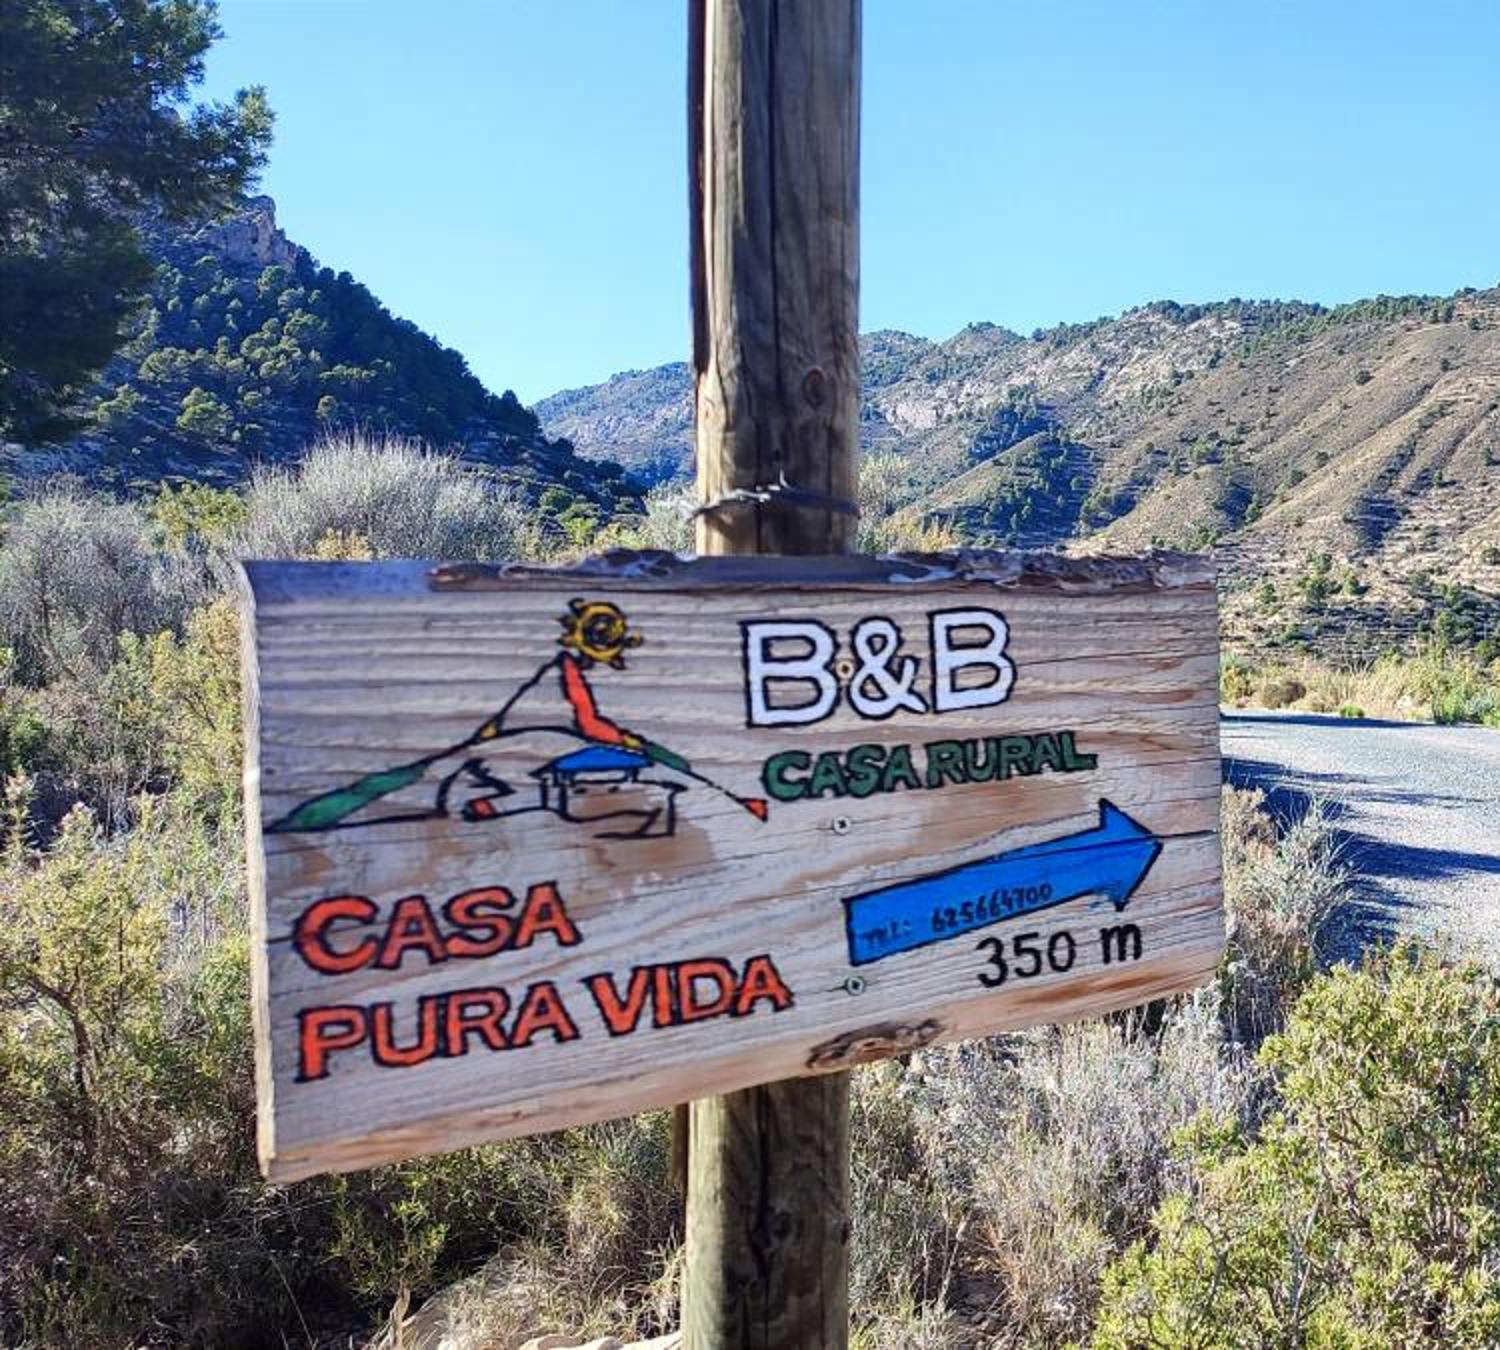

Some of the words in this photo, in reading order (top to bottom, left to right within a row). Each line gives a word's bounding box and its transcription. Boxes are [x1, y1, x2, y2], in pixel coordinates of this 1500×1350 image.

[740, 606, 1017, 728] B&B
[760, 744, 921, 800] CASA
[923, 730, 1098, 789] RURAL
[294, 880, 583, 975] CASA
[975, 936, 1077, 988] 350
[1100, 923, 1143, 965] m
[294, 980, 580, 1083] PURA
[580, 954, 795, 1037] VIDA
